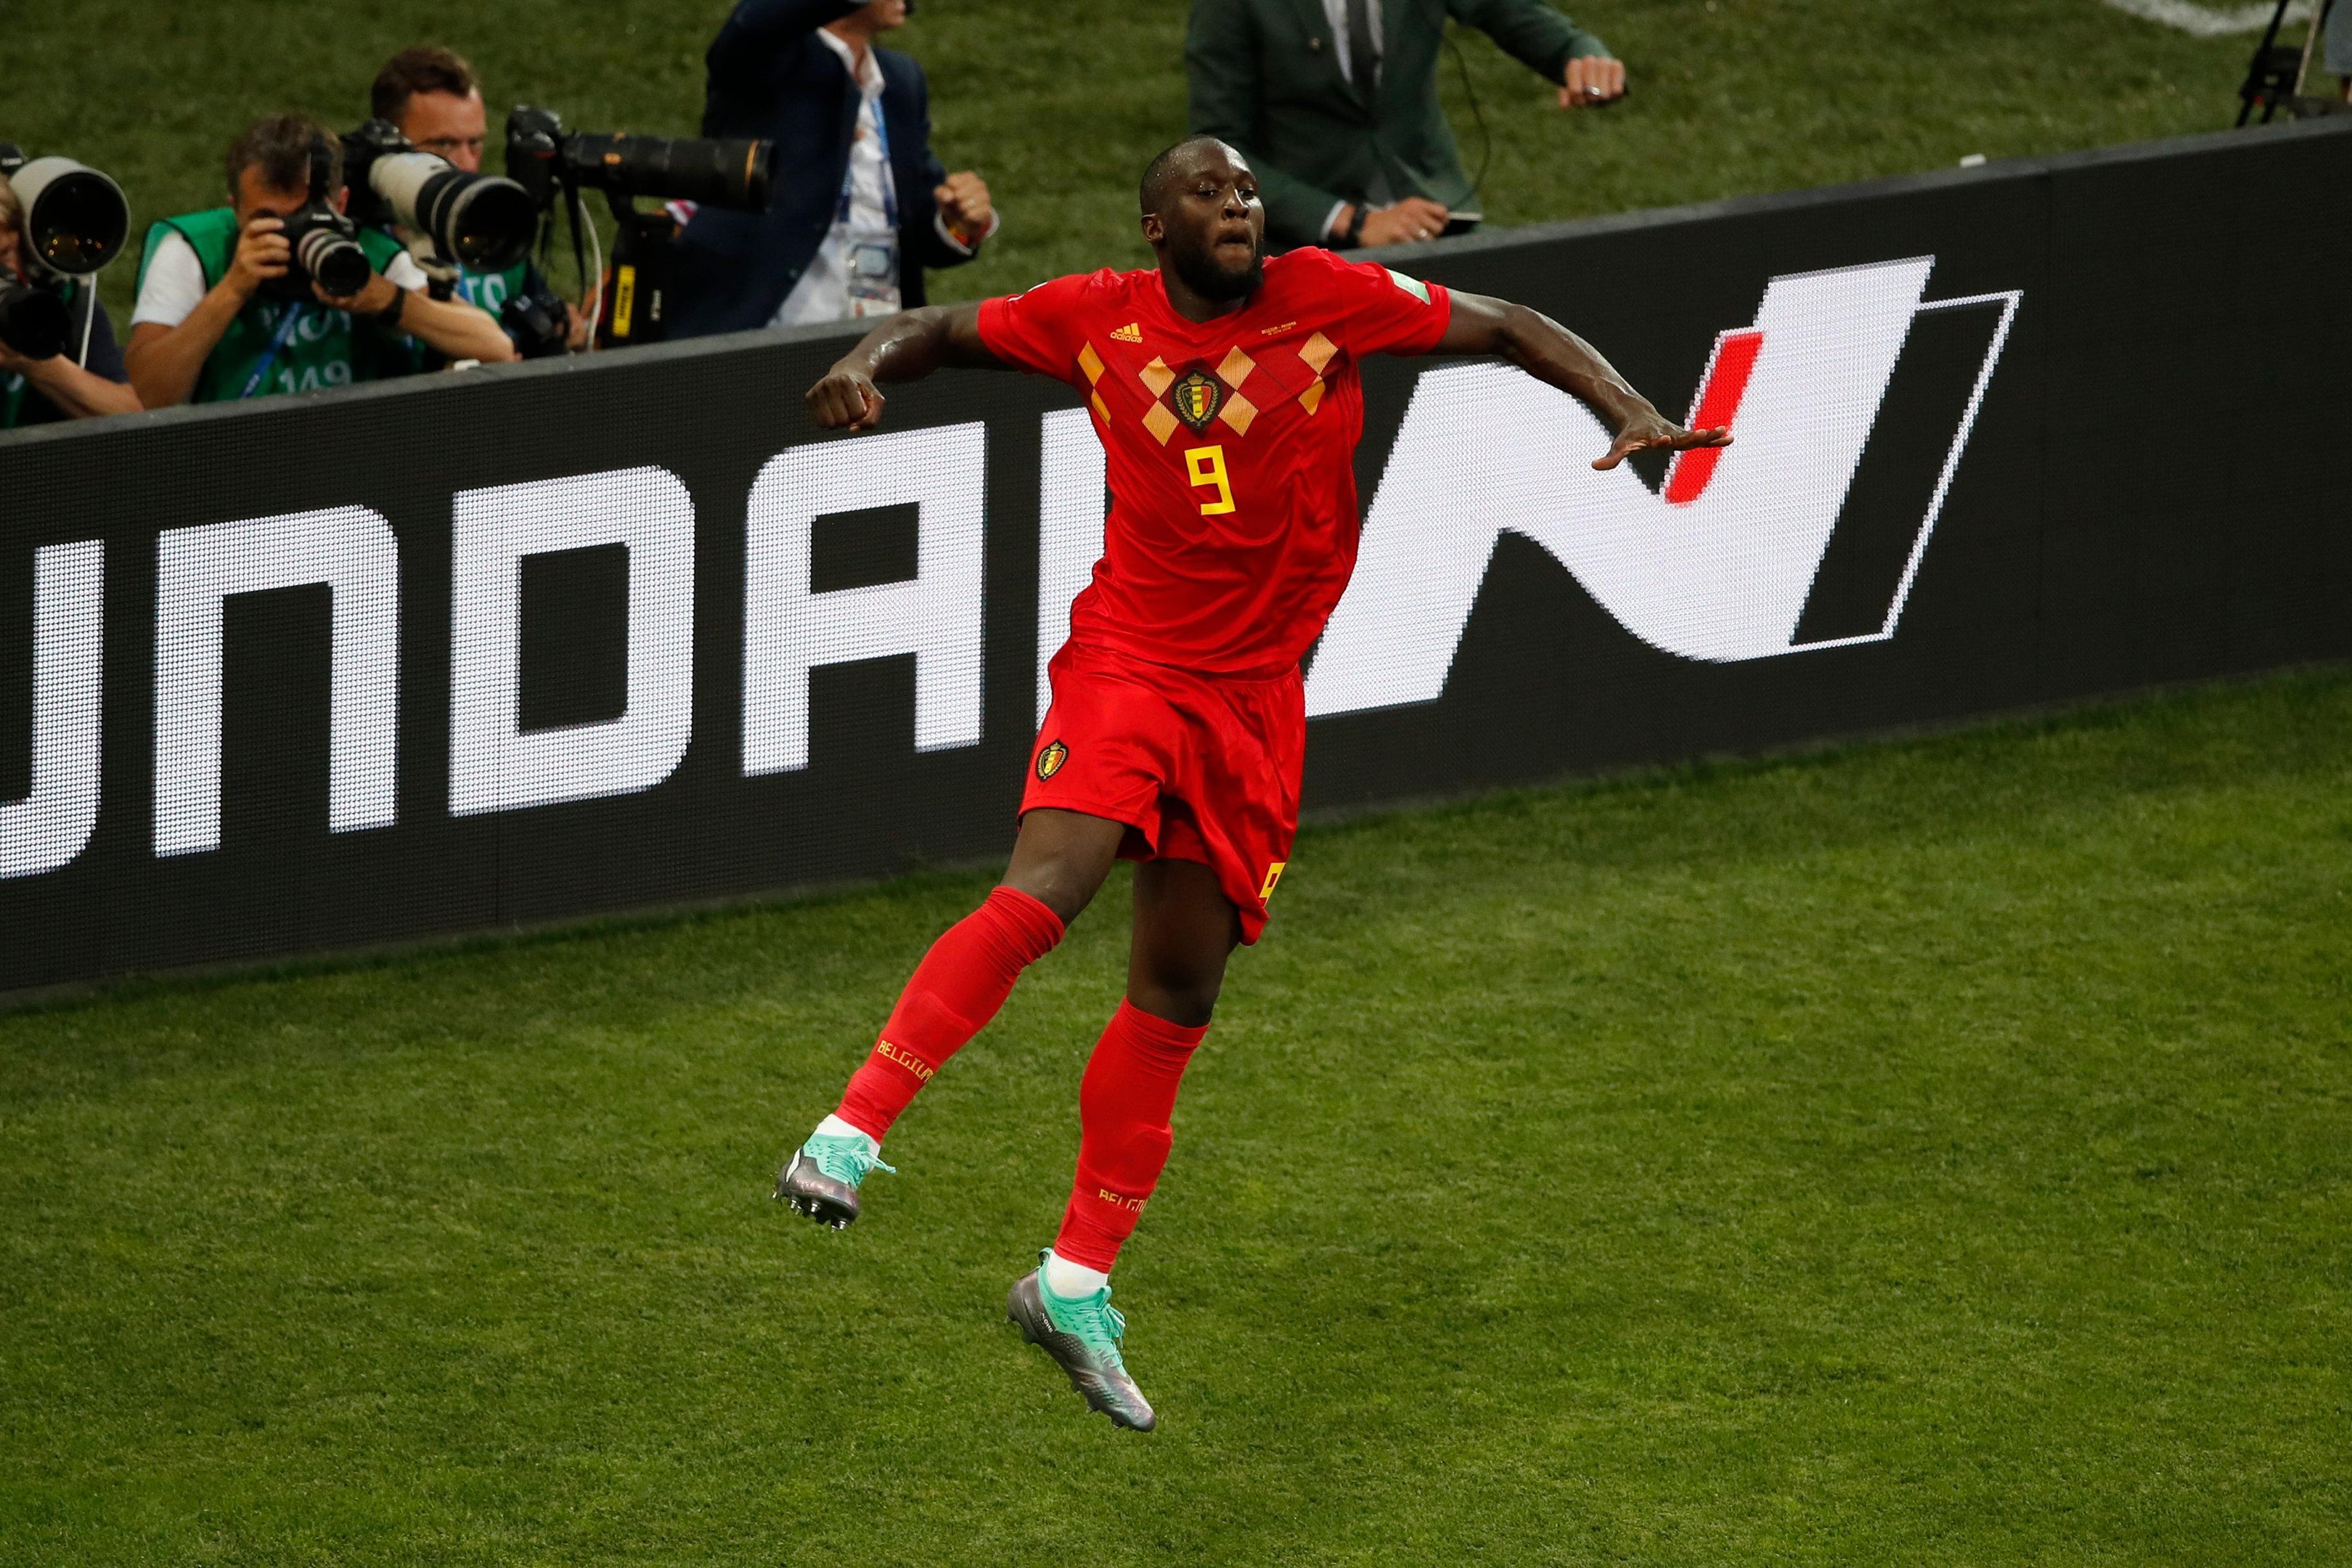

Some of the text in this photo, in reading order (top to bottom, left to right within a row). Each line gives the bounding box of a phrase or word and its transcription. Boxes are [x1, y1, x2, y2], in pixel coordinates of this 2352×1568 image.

[1110, 331, 1143, 343] adidas
[1185, 444, 1236, 516] 9
[877, 1040, 934, 1084] BELGIUM
